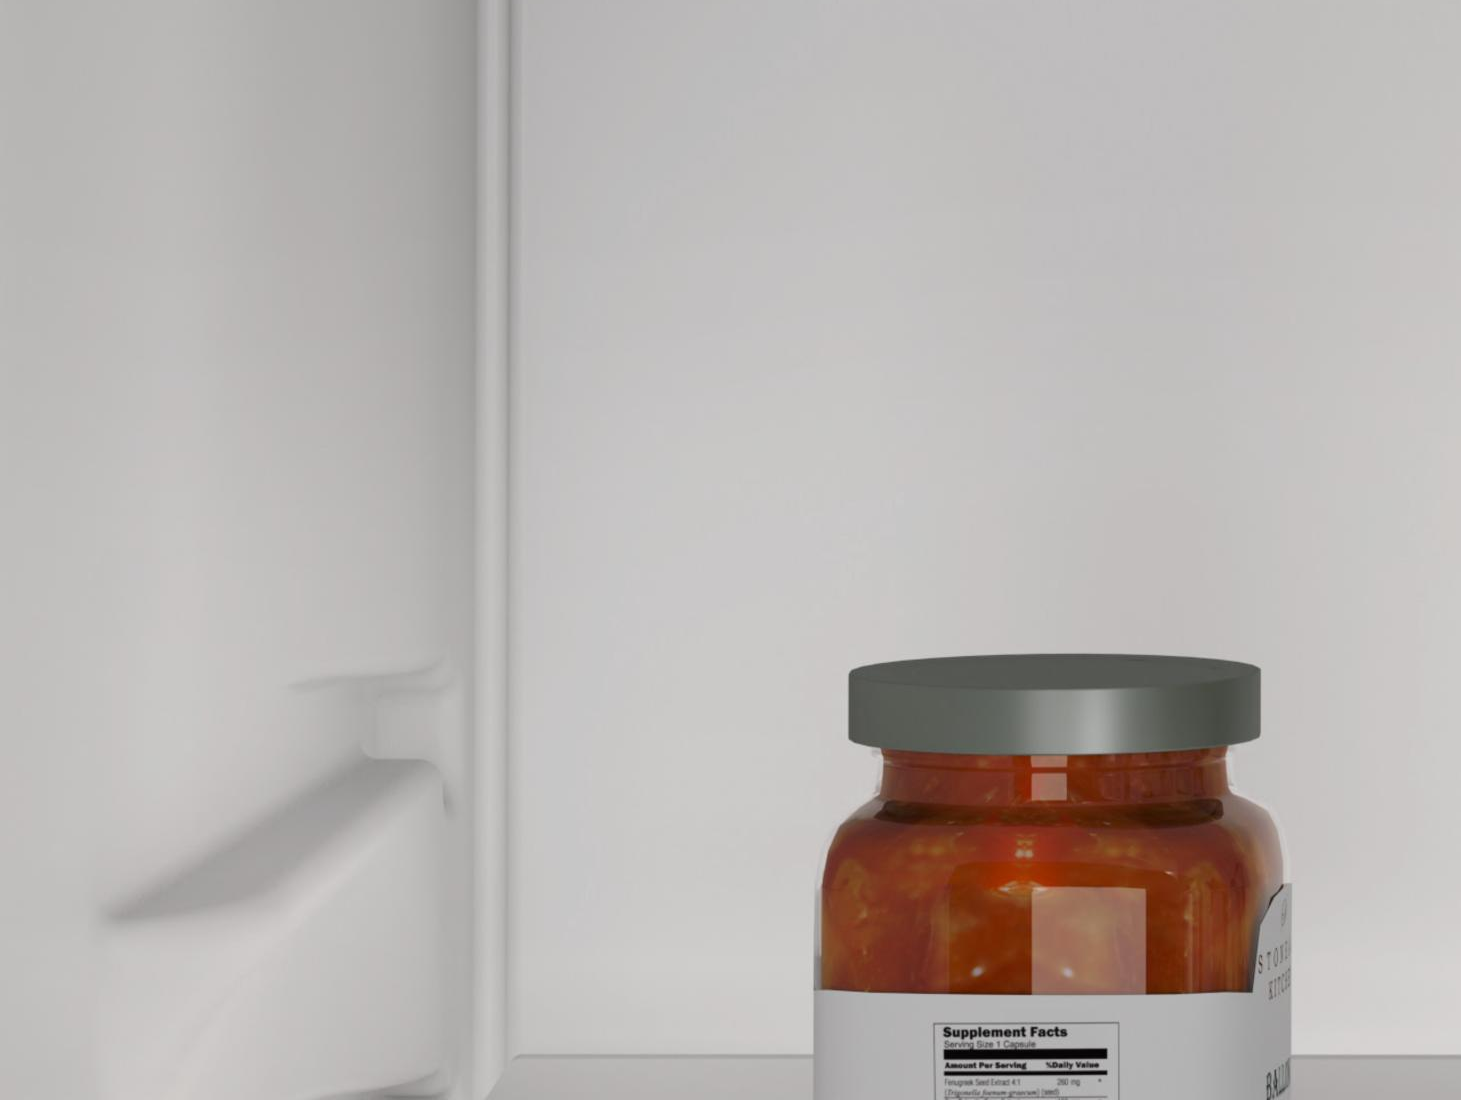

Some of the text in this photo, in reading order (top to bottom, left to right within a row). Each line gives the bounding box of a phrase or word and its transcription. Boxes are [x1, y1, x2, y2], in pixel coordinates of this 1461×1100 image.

[943, 1026, 1068, 1040] Supplement Facts
[944, 1040, 974, 1050] Serving
[976, 1040, 994, 1049] Size
[1003, 1040, 1036, 1049] Capsule
[995, 1062, 1027, 1070] Serving
[1075, 1061, 1100, 1069] Value
